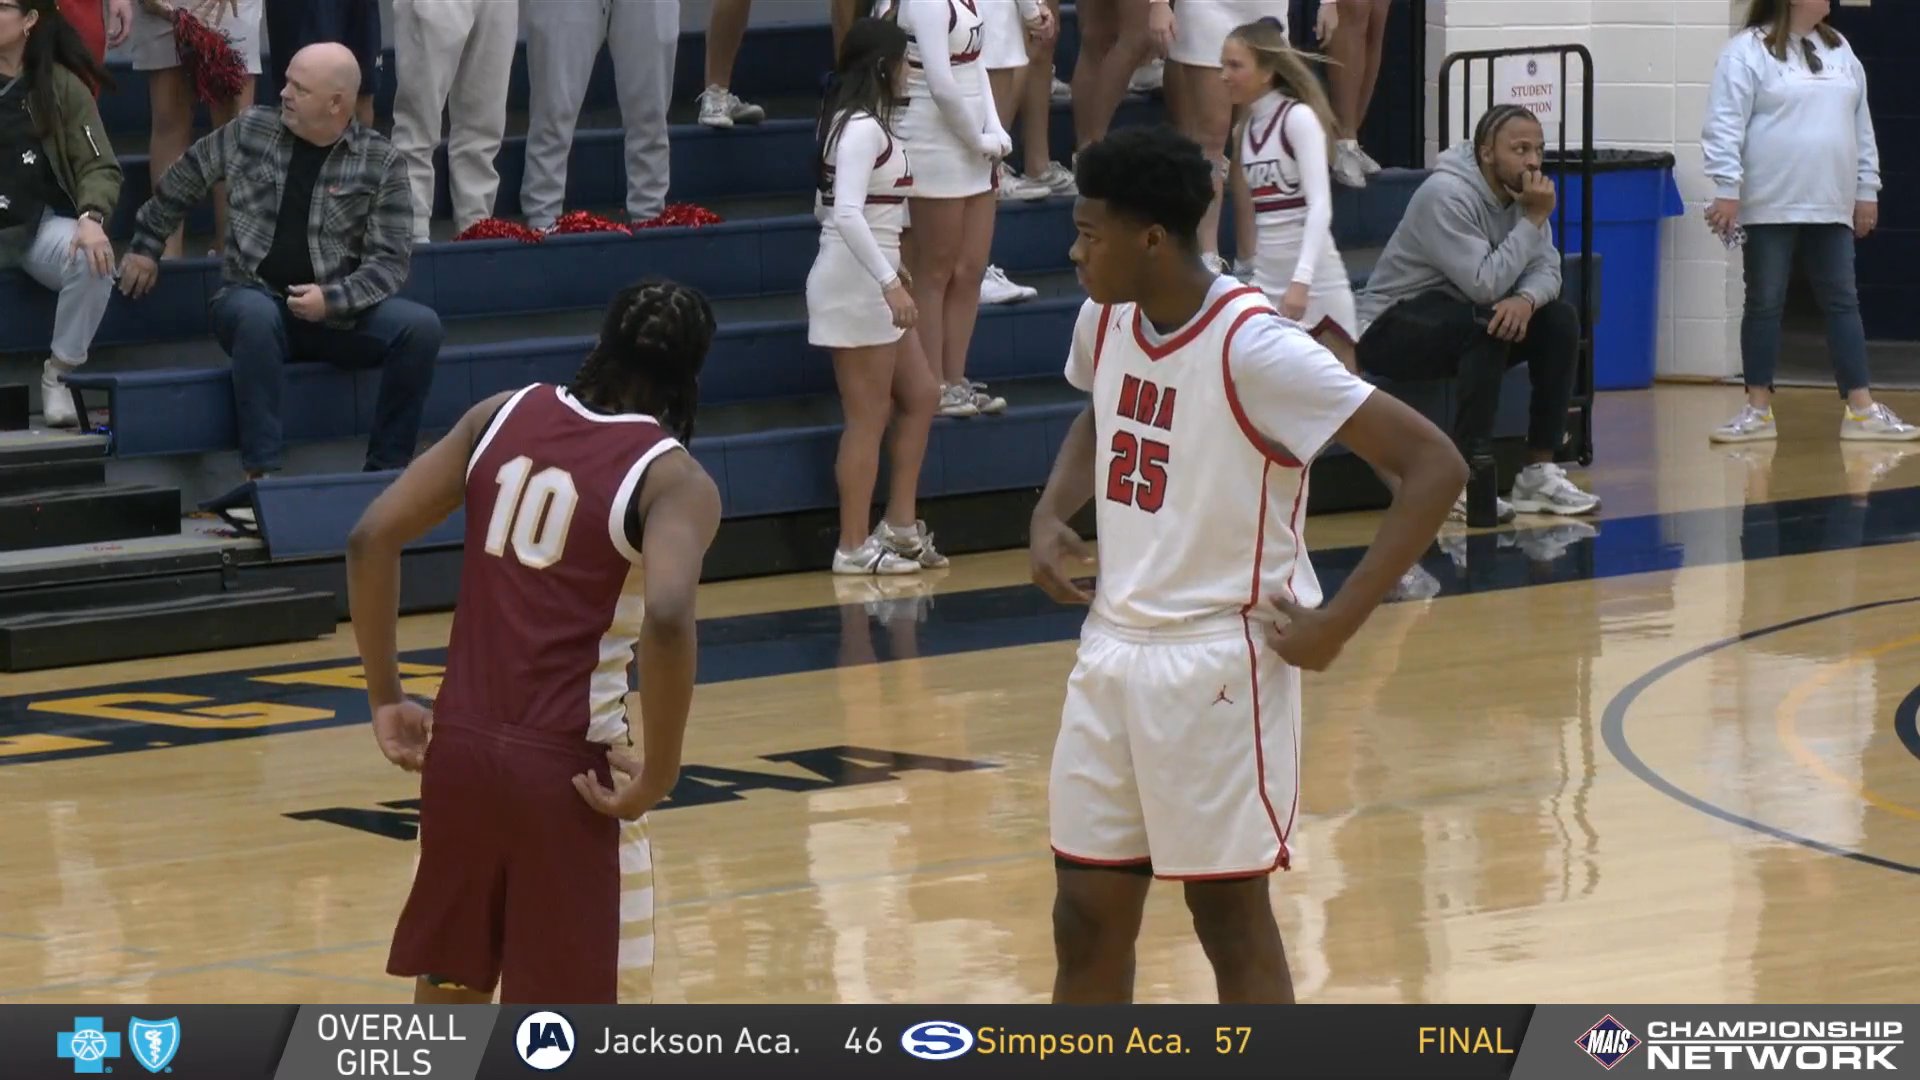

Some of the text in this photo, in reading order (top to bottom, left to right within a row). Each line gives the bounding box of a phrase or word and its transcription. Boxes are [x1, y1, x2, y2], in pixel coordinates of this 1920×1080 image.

[1511, 84, 1553, 97] STUDENT
[1521, 101, 1552, 113] CTION
[1117, 373, 1176, 432] MRA
[1106, 429, 1170, 514] 25
[484, 455, 579, 570] 10
